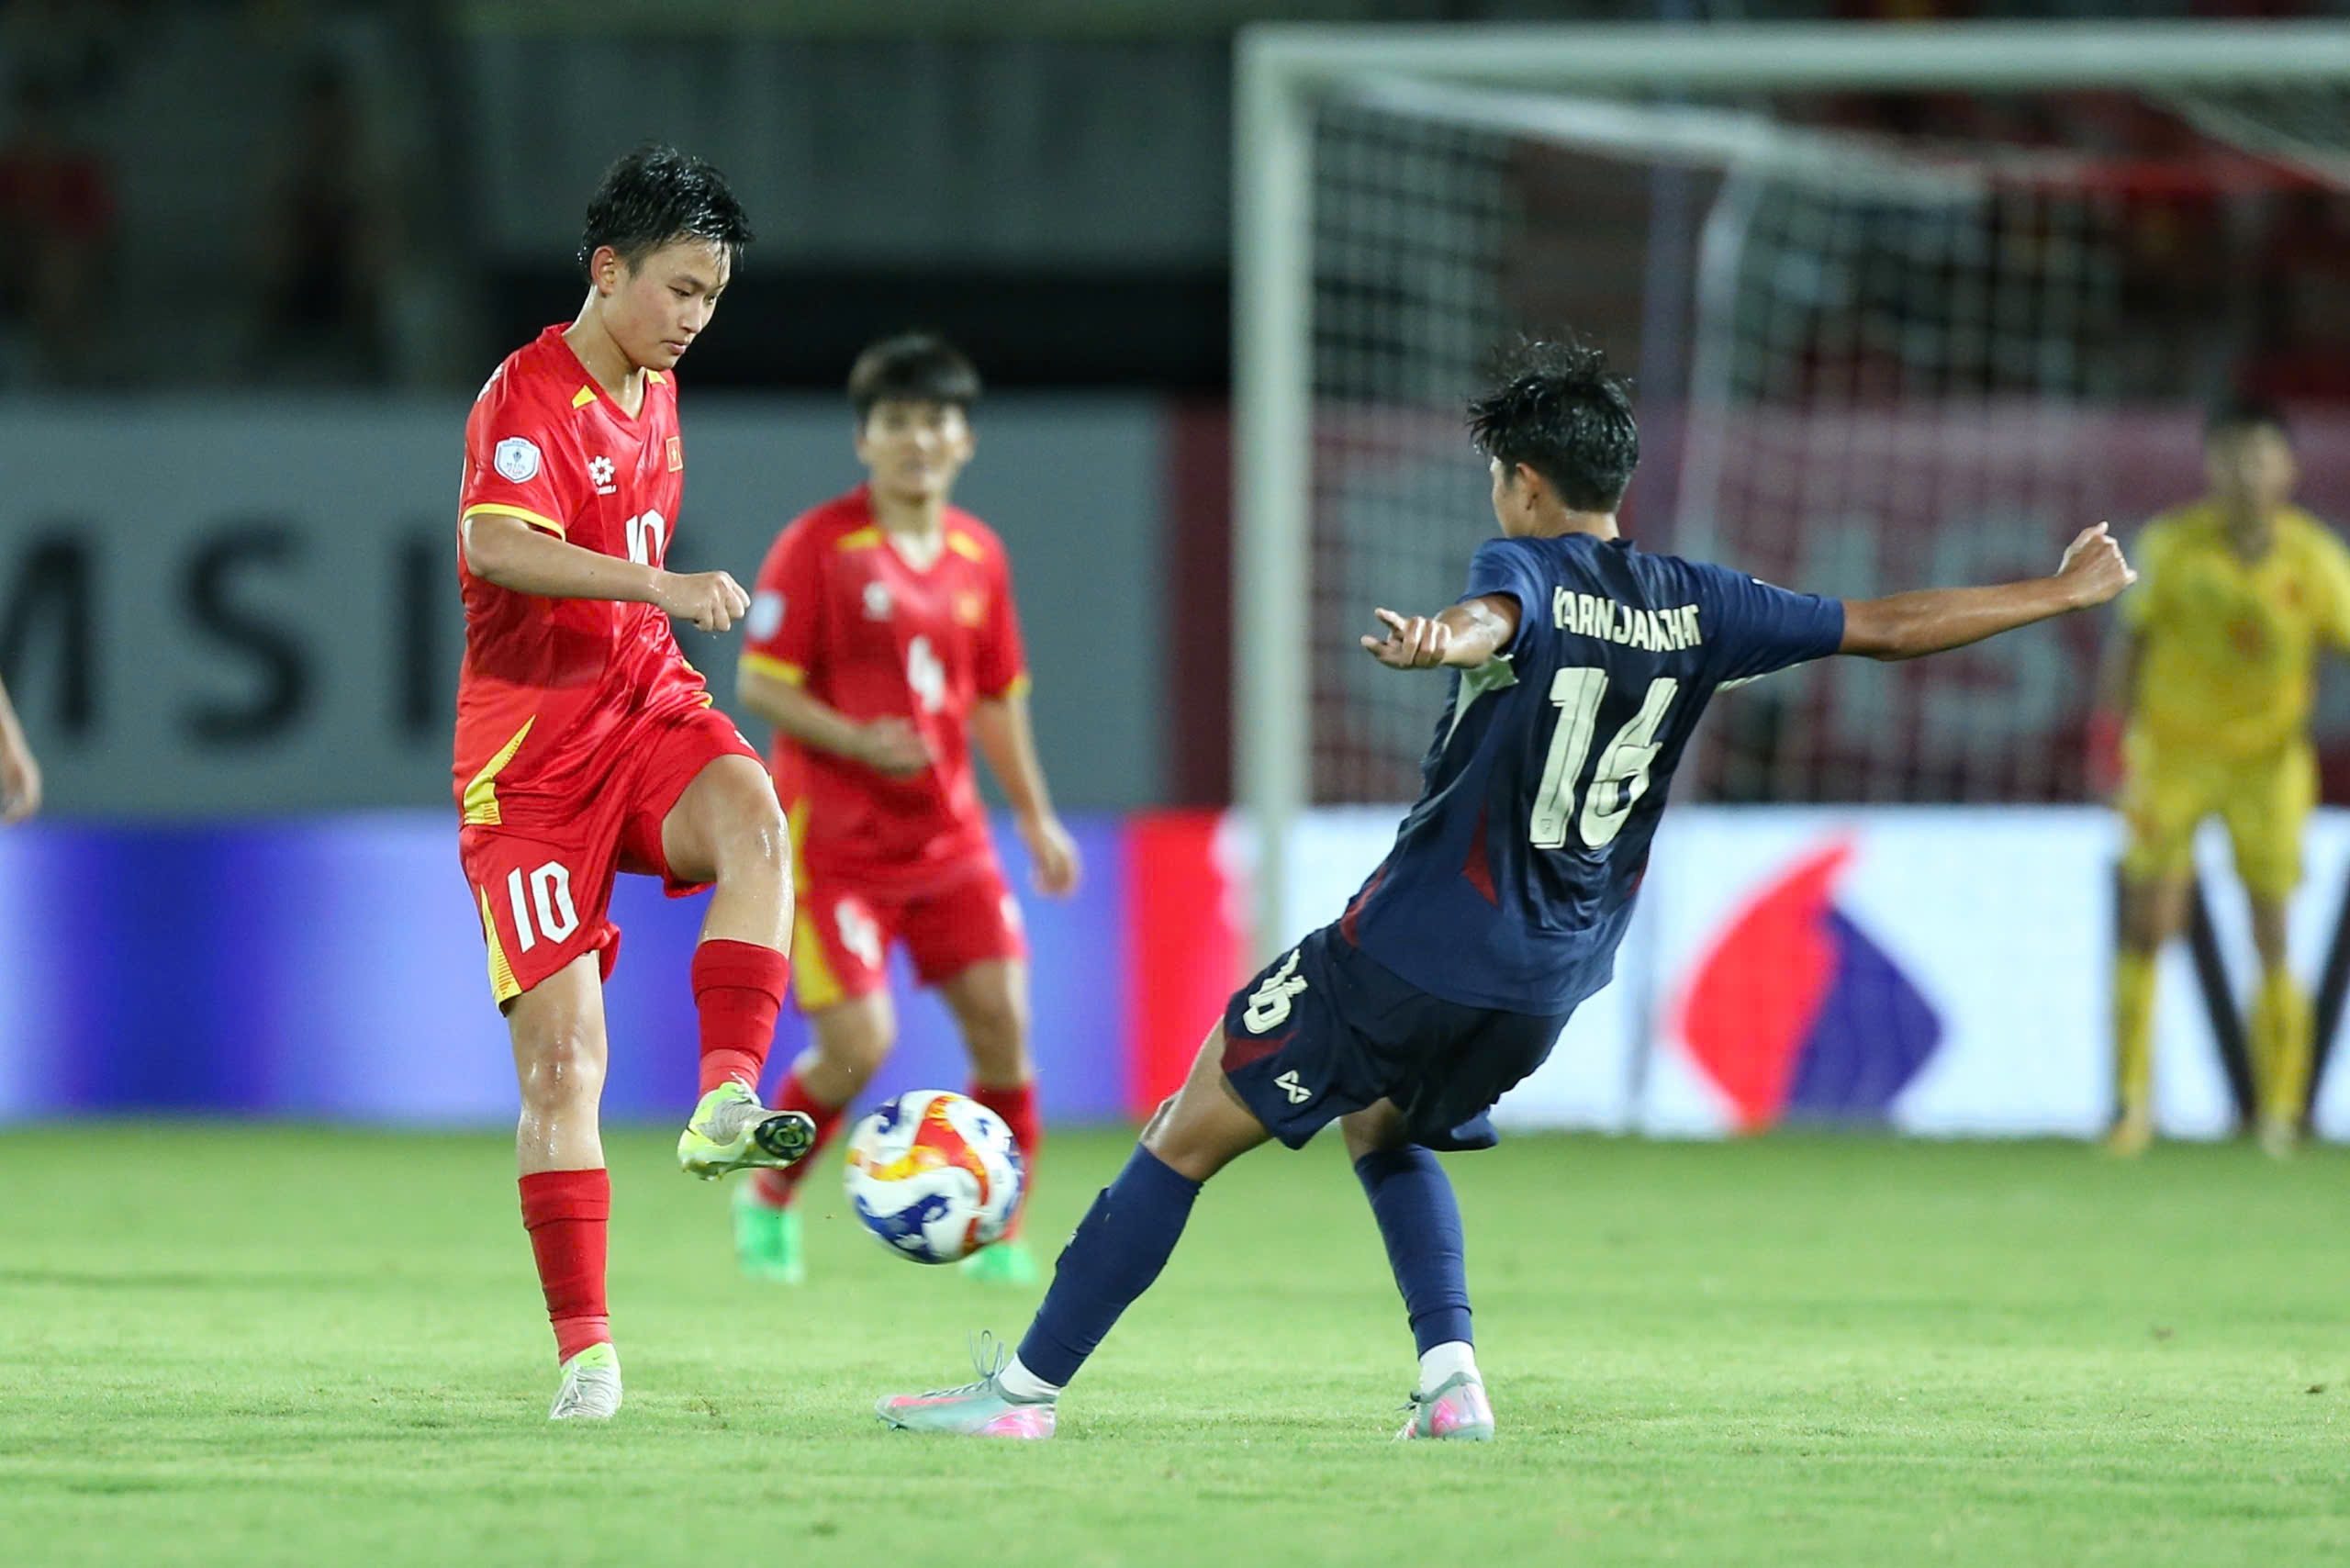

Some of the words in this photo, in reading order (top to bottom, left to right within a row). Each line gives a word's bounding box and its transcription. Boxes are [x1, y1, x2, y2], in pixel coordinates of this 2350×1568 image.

[626, 508, 665, 566] 10
[1529, 666, 1678, 850] 16
[508, 860, 580, 954] 10
